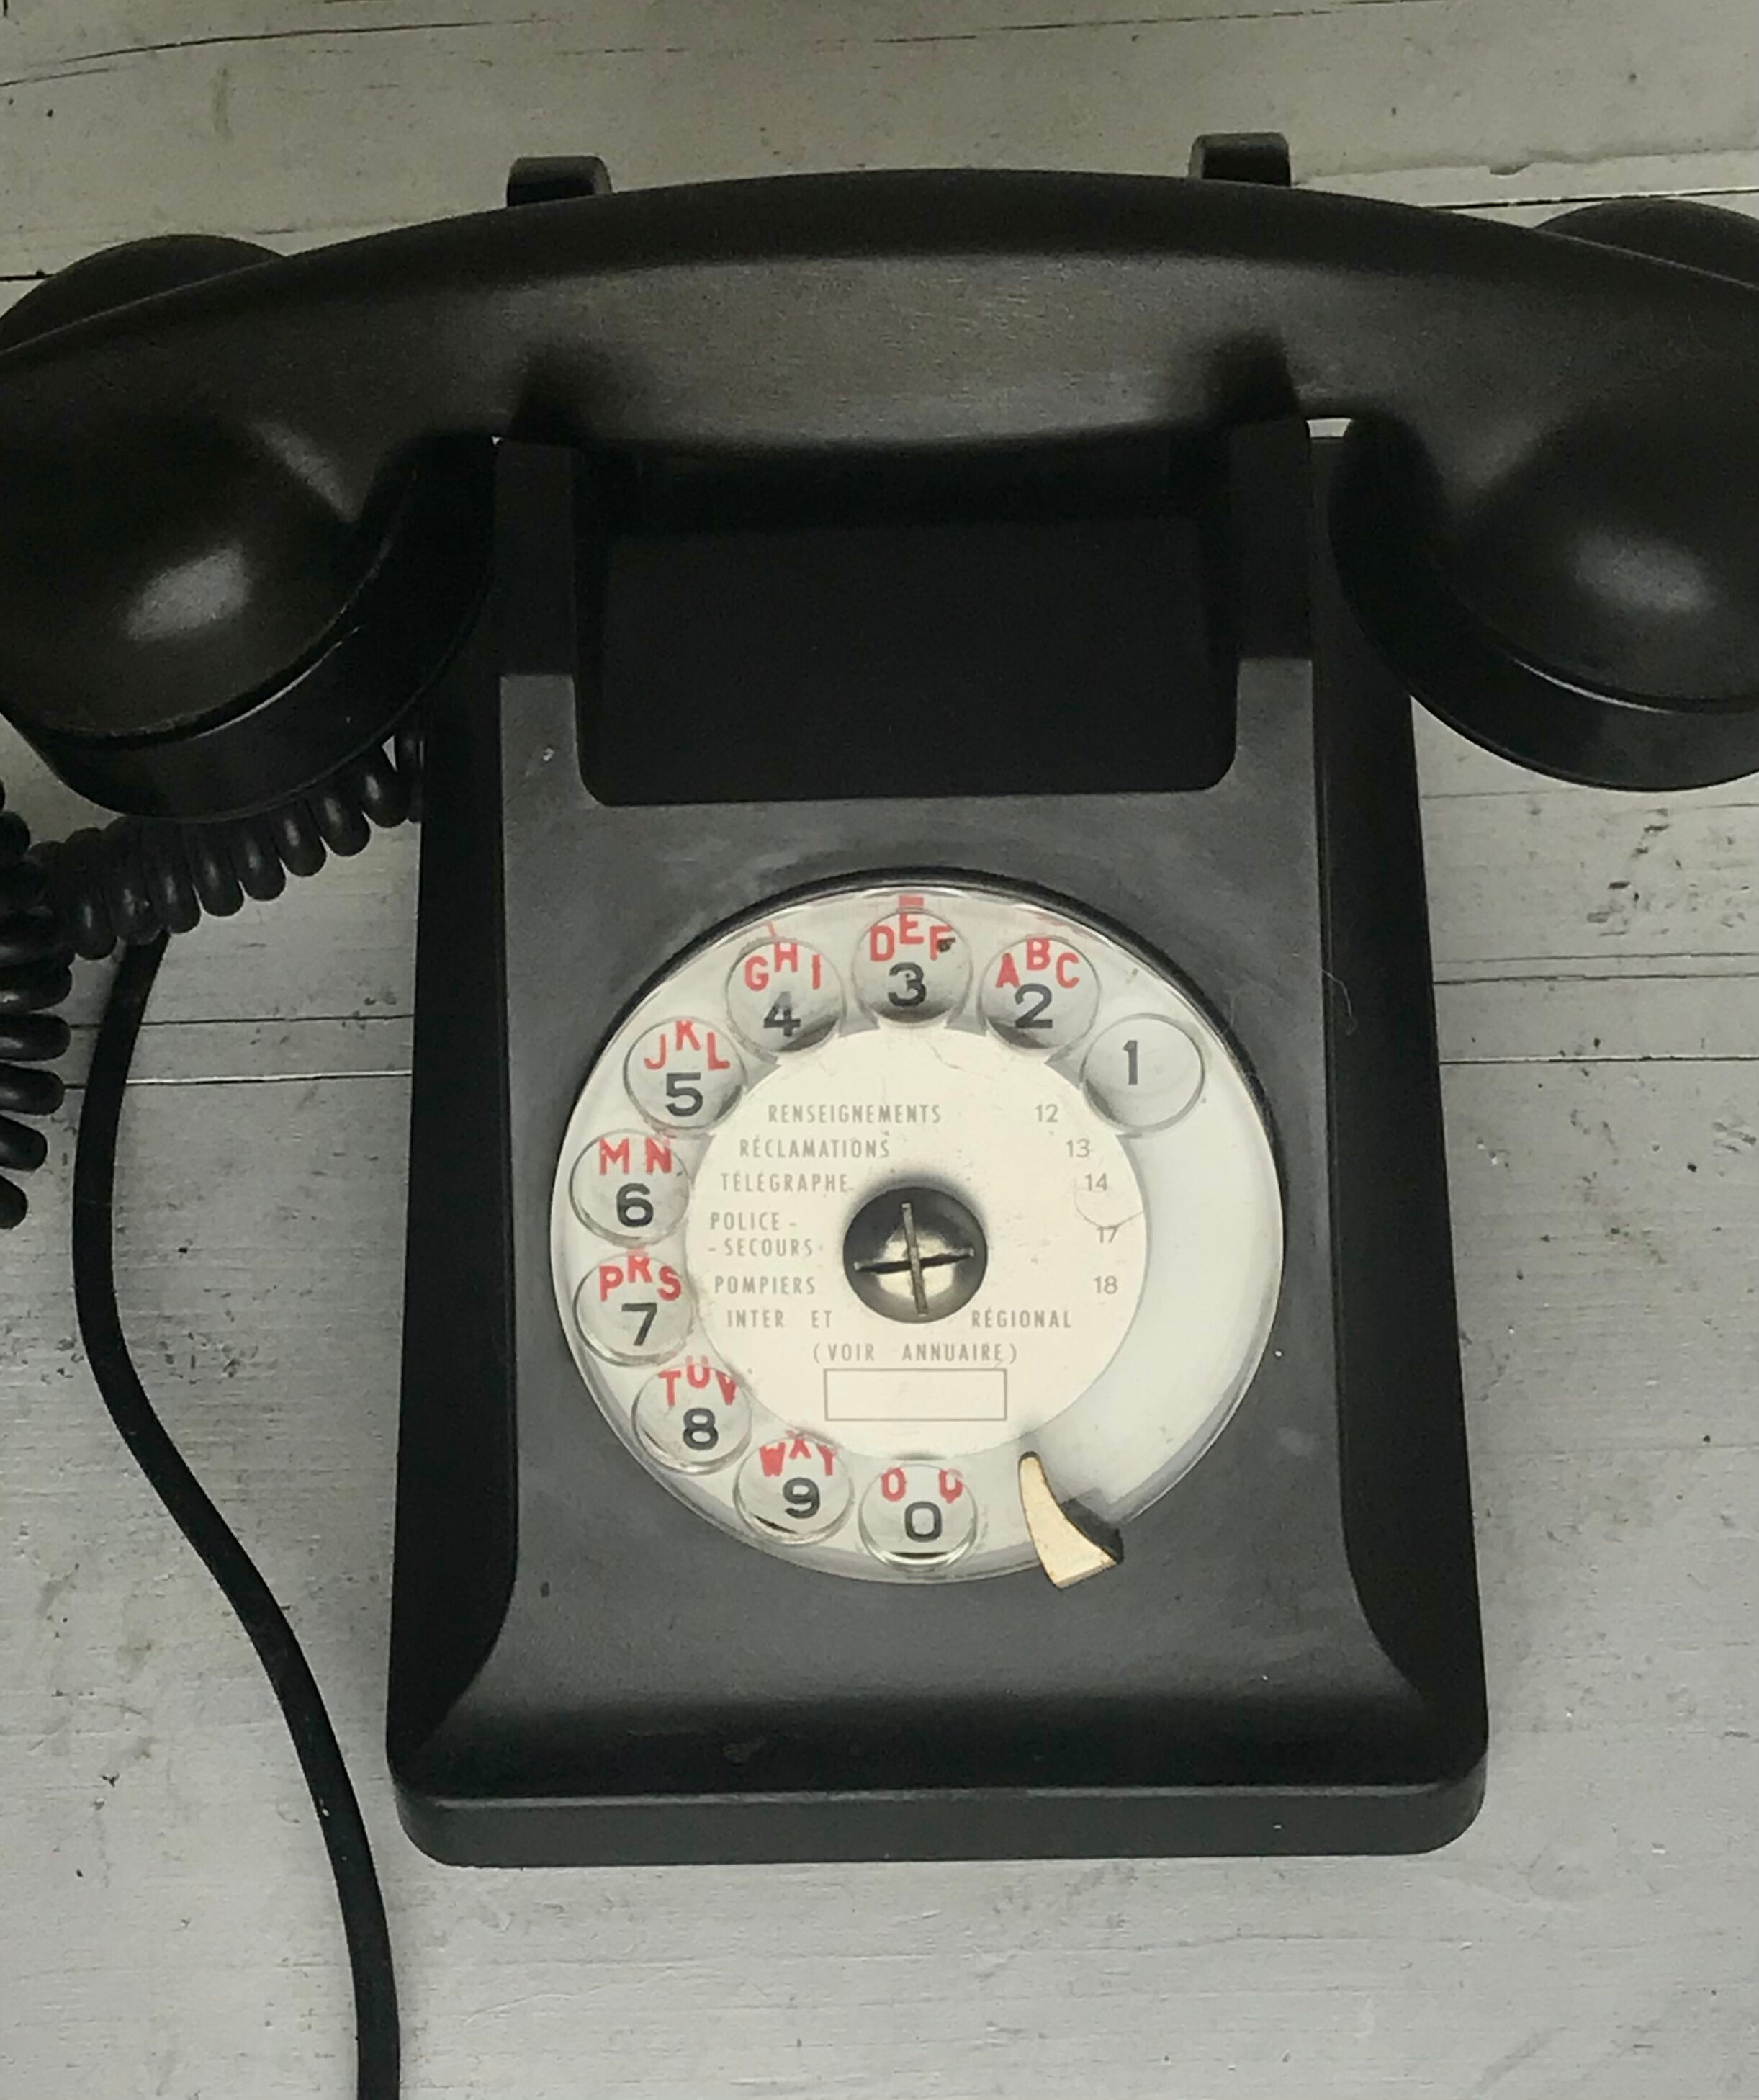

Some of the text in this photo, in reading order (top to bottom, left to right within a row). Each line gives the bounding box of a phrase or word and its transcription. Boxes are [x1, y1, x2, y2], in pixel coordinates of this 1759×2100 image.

[870, 896, 953, 961] DEF
[744, 941, 822, 992] GHI
[887, 962, 927, 1007] 3
[995, 935, 1080, 989] ABC
[762, 991, 801, 1037] 4
[1014, 983, 1053, 1029] 2
[644, 1020, 731, 1071] JKL
[1122, 1039, 1138, 1085] 1
[665, 1072, 704, 1117] 5
[768, 1104, 1059, 1124] RENSEIGNEMENTS 12
[739, 1134, 1091, 1159] RÉCLAMATIONS 13
[616, 1183, 654, 1227] 6
[1085, 1174, 1109, 1192] 14
[1097, 1226, 1119, 1244] 17
[598, 1249, 682, 1301] PRS
[714, 1275, 1118, 1295] POMPIERS 18
[621, 1302, 658, 1346] 7
[726, 1307, 1072, 1329] INTER ET RÉGIONAL
[657, 1357, 737, 1406] TUV
[682, 1407, 719, 1451] 8
[782, 1477, 820, 1520] 9
